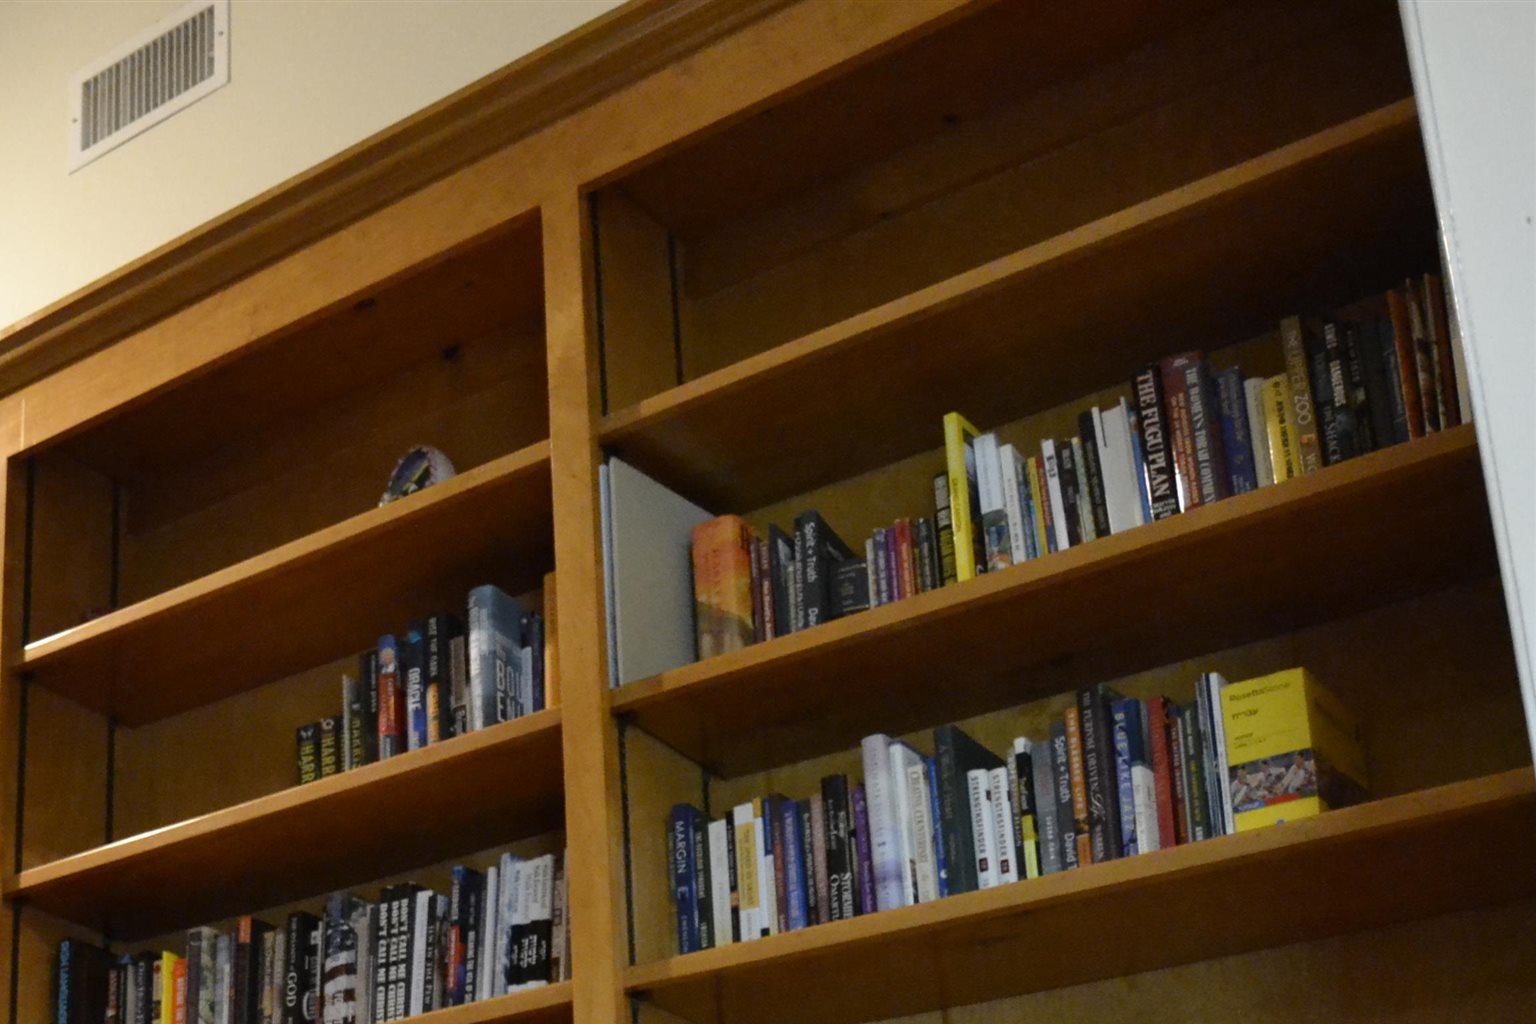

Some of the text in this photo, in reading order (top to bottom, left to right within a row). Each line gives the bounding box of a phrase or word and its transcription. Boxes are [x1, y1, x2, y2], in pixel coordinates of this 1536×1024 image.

[1136, 370, 1155, 405] THE
[1185, 368, 1198, 385] THE
[1294, 394, 1311, 424] ZOO
[1141, 408, 1161, 451] FUGU
[1324, 423, 1340, 463] SHACK
[1150, 452, 1170, 497] PLAN
[804, 522, 816, 547] Spirit
[807, 556, 818, 582] Truth
[408, 667, 421, 711] ORACLE
[1067, 713, 1076, 732] THE
[1083, 709, 1094, 750] PURPOSE
[1054, 736, 1066, 764] Spirit
[1059, 774, 1070, 803] Truth
[1086, 753, 1098, 792] DRIVEN
[1114, 712, 1134, 832] BLUE LIKE JAZZ
[971, 776, 986, 854] STRENGTHSFINDER
[992, 774, 1008, 857] STRENGTHSFINDER
[675, 821, 686, 873] MARGIN
[1064, 832, 1076, 862] David
[378, 903, 387, 936] DON'T
[391, 900, 399, 934] DON'T
[400, 898, 408, 931] DON'T
[378, 939, 386, 965] CALL
[389, 938, 398, 963] CALL
[398, 935, 407, 961] CALL
[377, 968, 385, 984] ME
[388, 966, 396, 981] ME
[397, 964, 406, 979] ME
[286, 972, 297, 1007] GOD
